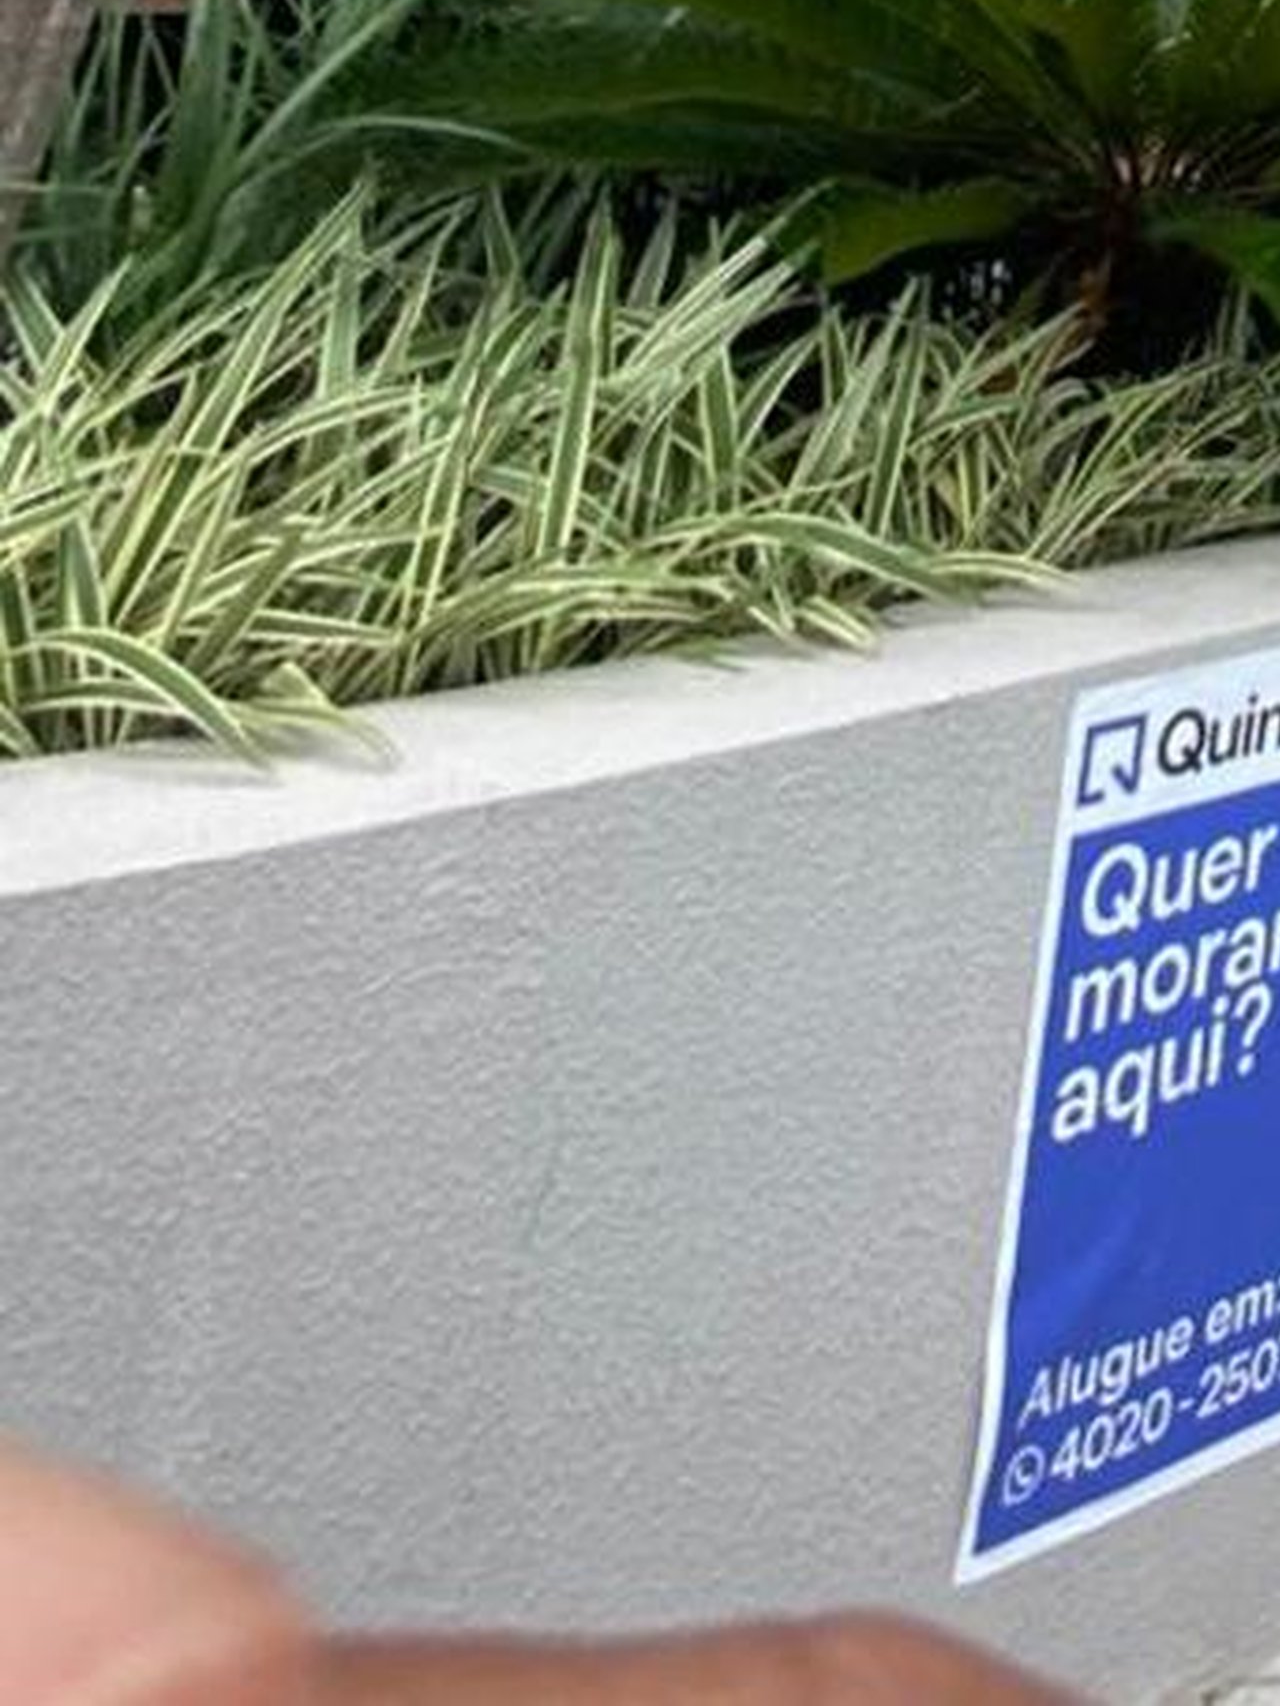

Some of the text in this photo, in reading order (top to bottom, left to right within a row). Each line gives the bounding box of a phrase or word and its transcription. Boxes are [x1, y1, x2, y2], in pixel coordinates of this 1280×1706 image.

[1082, 825, 1279, 938] Quer
[1053, 982, 1272, 1143] aqui?
[1016, 1316, 1195, 1431] Alugue
